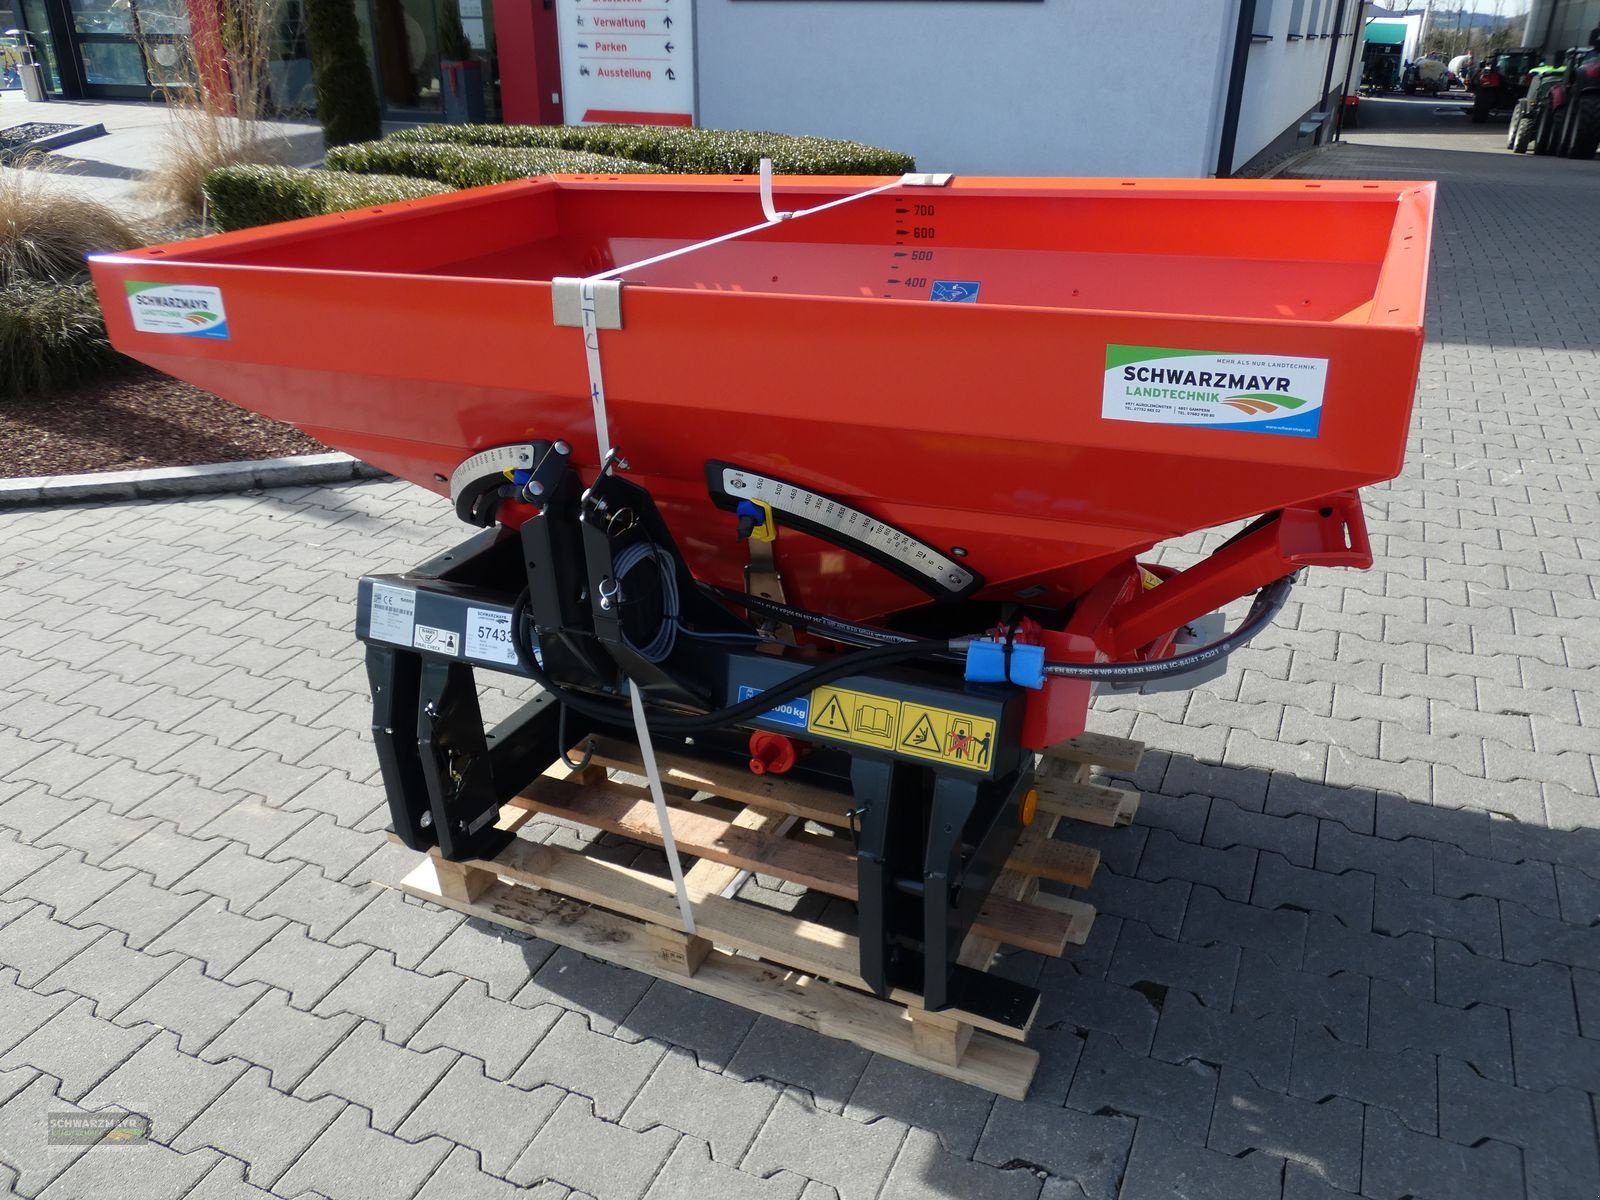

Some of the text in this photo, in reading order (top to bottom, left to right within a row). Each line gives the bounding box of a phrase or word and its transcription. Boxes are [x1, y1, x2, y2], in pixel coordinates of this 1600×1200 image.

[593, 16, 646, 30] Verwaltung
[595, 42, 627, 52] Parken
[597, 67, 652, 80] Ausstellung
[914, 205, 935, 216] 700
[914, 227, 935, 239] 600
[911, 251, 934, 261] 500
[904, 277, 927, 288] 400
[135, 294, 209, 310] SCHWARZMAYR
[1124, 366, 1291, 392] SCHWARZMAYR
[1125, 386, 1220, 403] LANDTECHNIK
[756, 478, 764, 490] 550
[775, 483, 783, 496] 500
[790, 488, 798, 500] 450
[804, 493, 812, 506] 400
[815, 497, 824, 510] 350
[826, 502, 835, 514] 300
[837, 507, 846, 519] 250
[849, 512, 858, 524] 200
[862, 518, 871, 528] 150
[875, 524, 885, 535] 100
[915, 550, 924, 558] 10
[415, 641, 427, 649] FINAL
[427, 643, 441, 651] CHECK
[1145, 663, 1168, 672] MSHA
[793, 707, 806, 719] kg
